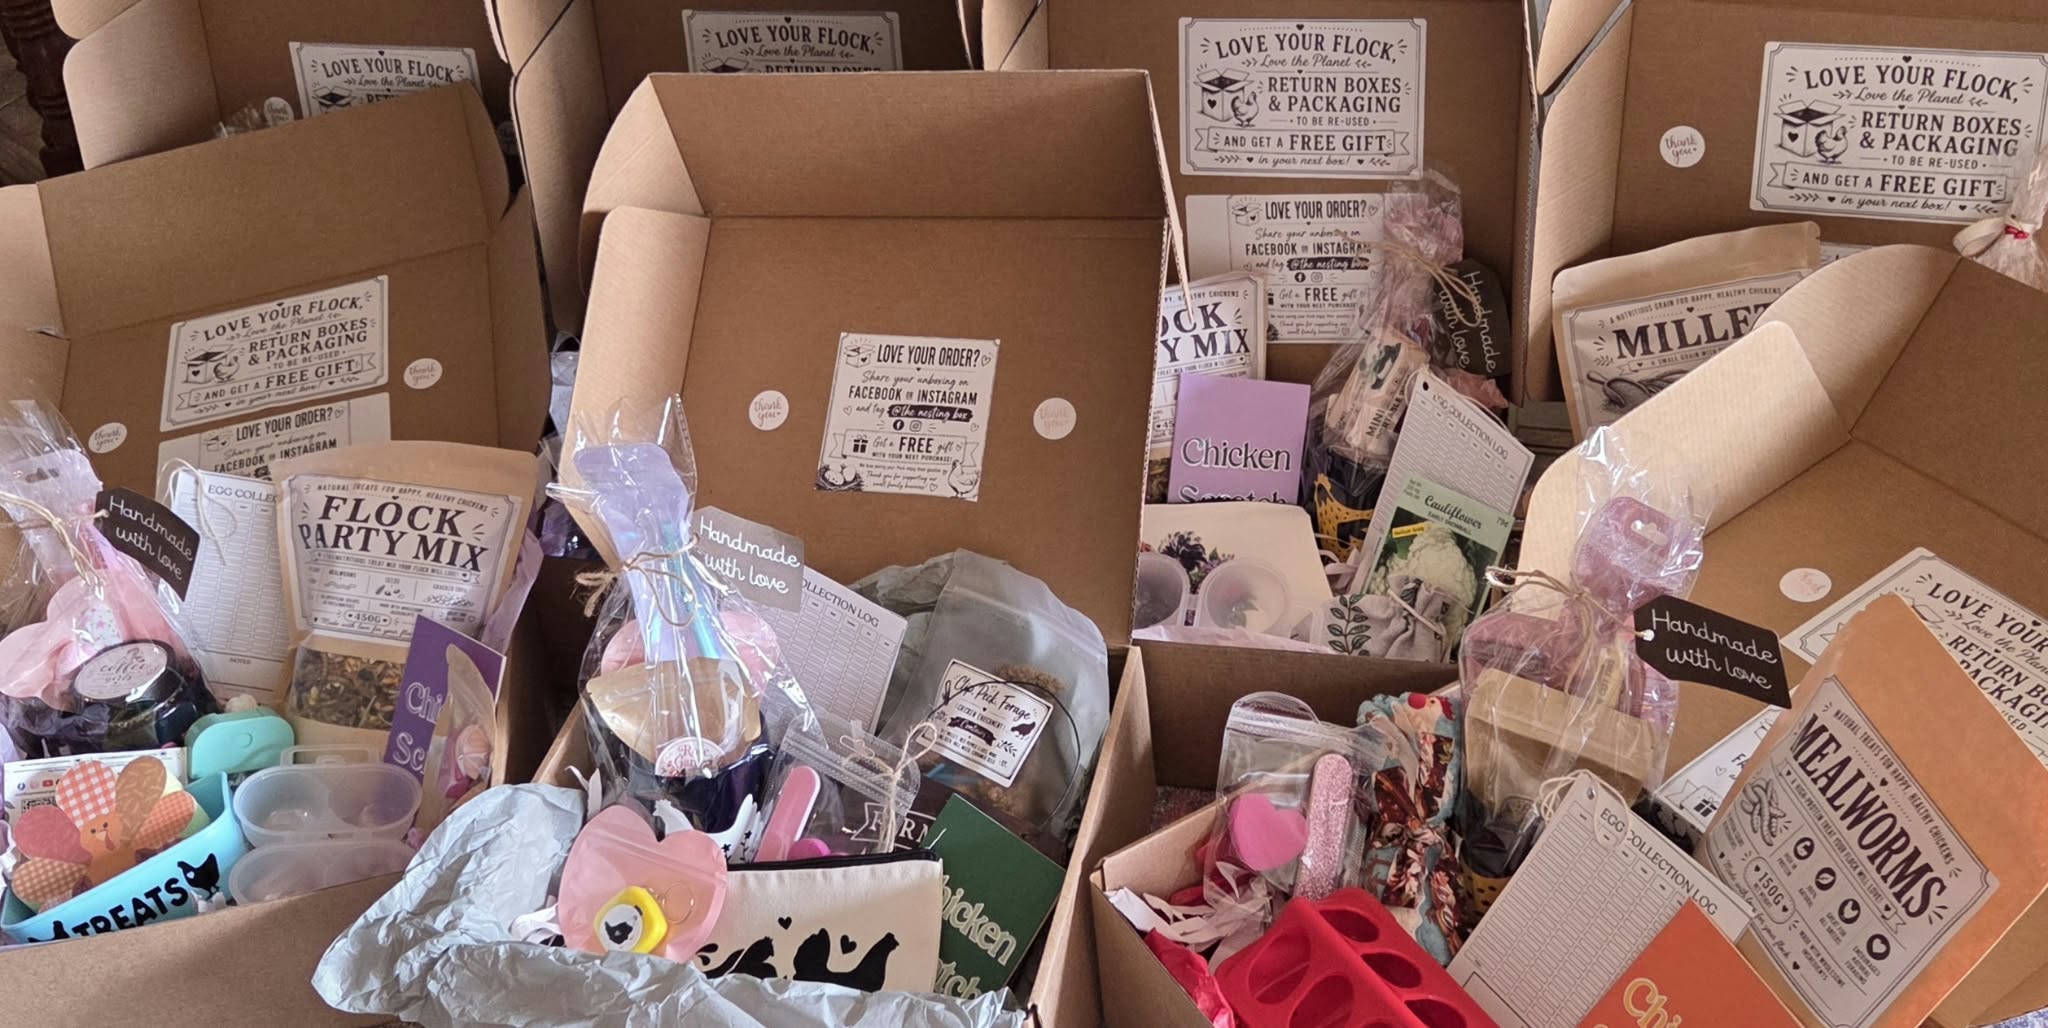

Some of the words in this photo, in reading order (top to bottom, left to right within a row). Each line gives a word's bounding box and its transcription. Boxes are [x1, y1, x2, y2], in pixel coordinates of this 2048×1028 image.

[715, 26, 762, 48] LOVE
[768, 25, 812, 42] YOUR
[818, 27, 874, 54] FLOCK,
[756, 45, 780, 57] Love
[784, 46, 799, 57] the
[802, 46, 836, 58] Planet
[1216, 34, 1267, 59] LOVE
[1275, 33, 1324, 51] YOUR
[1333, 37, 1397, 63] FLOCK,
[322, 59, 359, 78] LOVE
[364, 57, 403, 73] YOUR
[1260, 55, 1286, 67] Love
[1291, 55, 1309, 66] the
[1312, 55, 1351, 67] Planet
[381, 77, 394, 86] the
[396, 77, 424, 88] Planet
[1268, 77, 1336, 93] RETURN
[1344, 77, 1401, 93] BOXES
[1804, 65, 1866, 90] LOVE
[1877, 65, 1934, 86] YOUR
[1943, 69, 2019, 103] FLOCK,
[1854, 88, 1887, 102] Love
[1892, 88, 1914, 103] the
[1917, 90, 1963, 105] Planet
[1269, 97, 1281, 111] &
[1288, 96, 1400, 113] PACKAGING
[1297, 117, 1308, 125] TO
[1312, 117, 1323, 126] BE
[1328, 117, 1369, 126] RE-USED
[1861, 111, 1945, 132] RETURN
[1952, 116, 2022, 136] BOXES
[1224, 136, 1246, 147] AND
[1252, 137, 1271, 147] GET
[1277, 137, 1283, 147] A
[1290, 135, 1335, 150] FREE
[1343, 136, 1386, 151] GIFT
[1860, 133, 1874, 148] &
[1882, 134, 2018, 156] PACKAGING
[1259, 156, 1269, 164] in
[1272, 157, 1298, 167] your
[1301, 156, 1322, 164] next
[1326, 156, 1349, 165] box!
[1892, 155, 1904, 165] TO
[1910, 156, 1922, 166] BE
[1928, 157, 1978, 169] RE-USED
[1803, 172, 1829, 186] AND
[1835, 174, 1861, 187] GET
[1865, 176, 1872, 188] A
[1880, 174, 1935, 194] FREE
[1943, 178, 1996, 197] GIFT
[1265, 201, 1291, 220] LOVE
[1294, 201, 1323, 218] YOUR
[1327, 200, 1367, 218] ORDER?
[1841, 194, 1853, 205] in
[1857, 196, 1887, 210] your
[1891, 197, 1919, 209] next
[1922, 200, 1950, 211] box!
[1246, 243, 1297, 256] FACEBOOK
[1255, 228, 1282, 238] Share
[1286, 229, 1305, 242] your
[1305, 288, 1337, 301] FREE
[204, 317, 251, 341] LOVE
[258, 304, 302, 323] YOUR
[308, 296, 363, 313] FLOCK,
[248, 354, 260, 366] &
[266, 331, 367, 363] PACKAGING
[249, 329, 311, 352] RETURN
[318, 318, 368, 338] BOXES
[1192, 329, 1250, 359] MIX
[1453, 330, 1470, 369] love
[274, 362, 284, 370] TO
[288, 359, 297, 367] BE
[877, 344, 904, 364] LOVE
[908, 345, 935, 366] YOUR
[939, 348, 981, 368] ORDER?
[204, 388, 226, 401] AND
[230, 384, 250, 395] GET
[265, 369, 308, 388] FREE
[315, 359, 354, 378] GIFT
[862, 371, 890, 383] Share
[891, 376, 914, 388] your
[917, 375, 956, 389] unboxing
[849, 385, 902, 401] FACEBOOK
[917, 389, 977, 405] INSTAGRAM
[236, 424, 261, 442] LOVE
[265, 416, 292, 433] YOUR
[295, 407, 333, 428] ORDER?
[872, 404, 885, 418] tag
[917, 407, 950, 422] nesting
[953, 408, 968, 420] box
[213, 454, 265, 473] FACEBOOK
[280, 439, 337, 459] INSTAGRAM
[873, 436, 888, 448] Get
[899, 436, 934, 453] FREE
[936, 441, 953, 454] gift
[1182, 436, 1291, 472] Chicken
[208, 485, 233, 496] EGG
[318, 495, 466, 538] FLOCK
[1425, 495, 1482, 529] Cauliflower
[109, 495, 193, 561] Handmade
[700, 515, 800, 568] Handmade
[116, 526, 155, 556] with
[157, 549, 183, 580] love
[298, 524, 408, 556] PARTY
[412, 534, 488, 572] MIX
[704, 553, 745, 581] with
[750, 566, 789, 594] love
[803, 578, 857, 614] OLLECTION
[857, 609, 880, 627] LOG
[354, 612, 382, 624] 450G
[1928, 583, 1993, 619] LOVE
[1995, 613, 2048, 653] YOUR
[1651, 608, 1777, 665] Handmade
[1963, 619, 1993, 640] Love
[1994, 637, 2016, 653] the
[1666, 647, 1723, 673] with
[1724, 657, 1772, 691] love
[1948, 635, 2029, 688] RETURN
[998, 694, 1031, 722] Forage
[1833, 710, 1861, 736] NATURAL
[1860, 732, 1883, 757] TREATS
[1908, 793, 1934, 825] HEALTHY
[1929, 825, 1955, 865] CHICKENS
[1791, 713, 1946, 918] MEALWORMS
[1600, 807, 1625, 834] EGG
[1626, 829, 1694, 896] COLLECTION
[1692, 889, 1718, 917] LOG
[1844, 852, 1859, 872] FLOCK
[1758, 872, 1785, 906] 150G
[71, 877, 189, 937] TREATS
